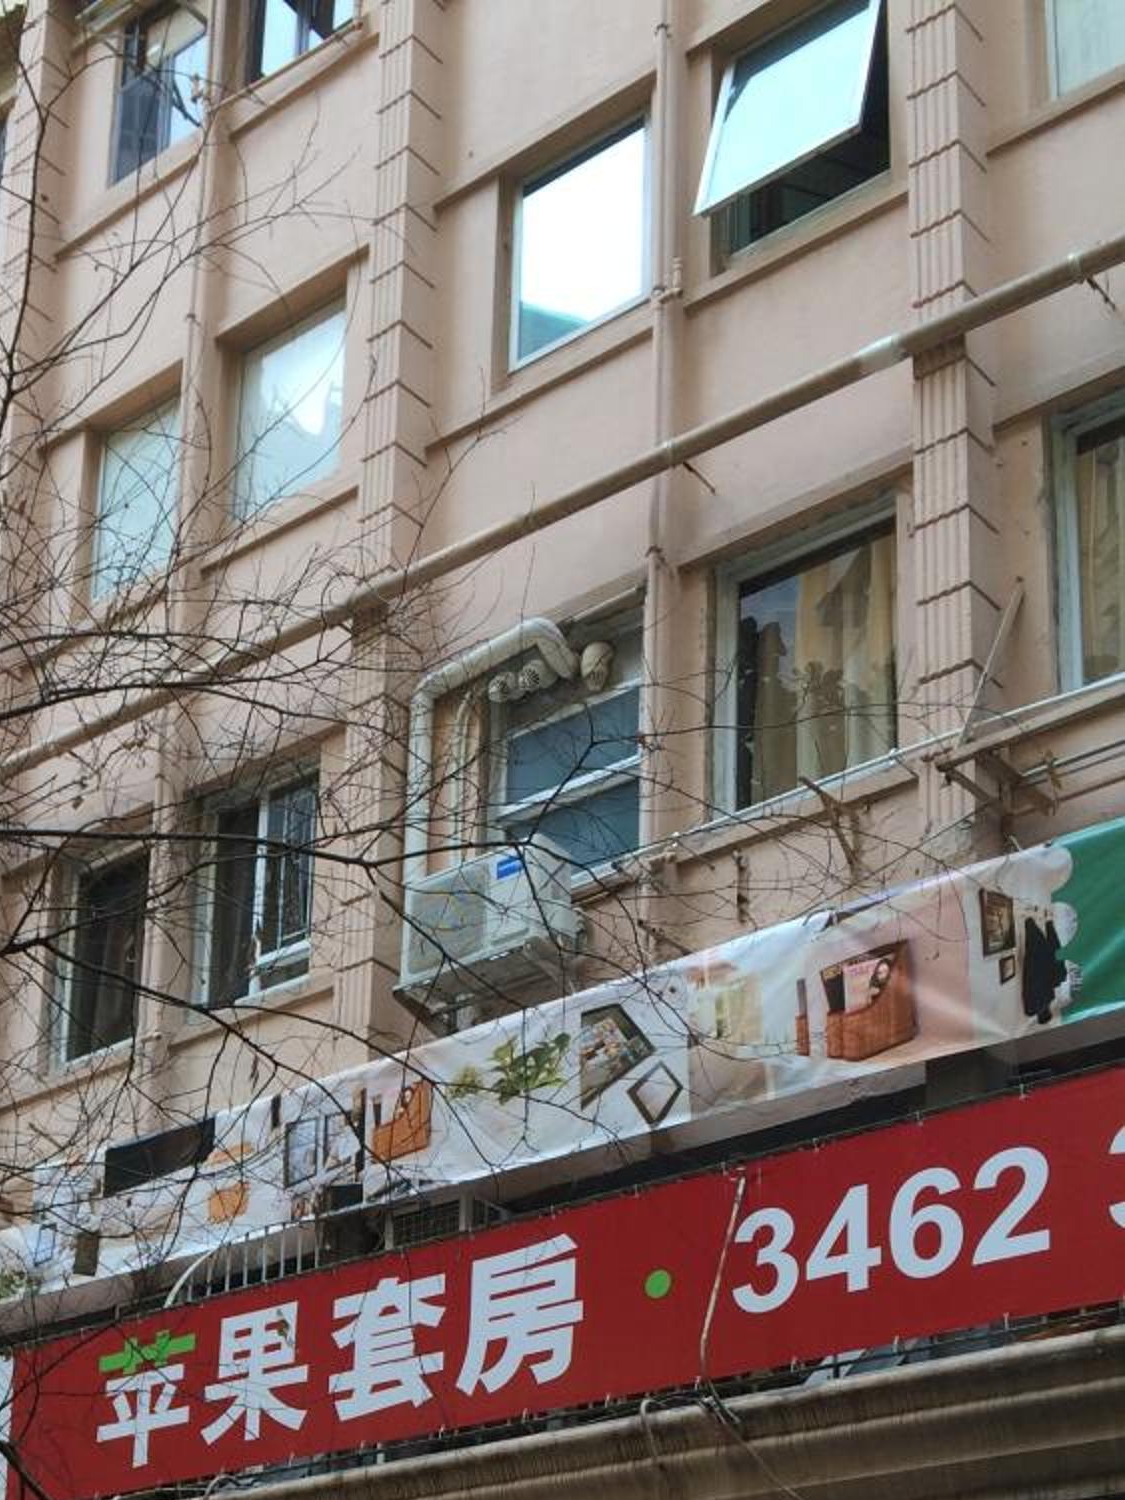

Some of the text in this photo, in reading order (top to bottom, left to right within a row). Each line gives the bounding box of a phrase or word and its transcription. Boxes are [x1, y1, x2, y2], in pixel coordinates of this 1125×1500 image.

[96, 1232, 584, 1469] 苹果套房
[732, 1146, 1051, 1314] 3462
